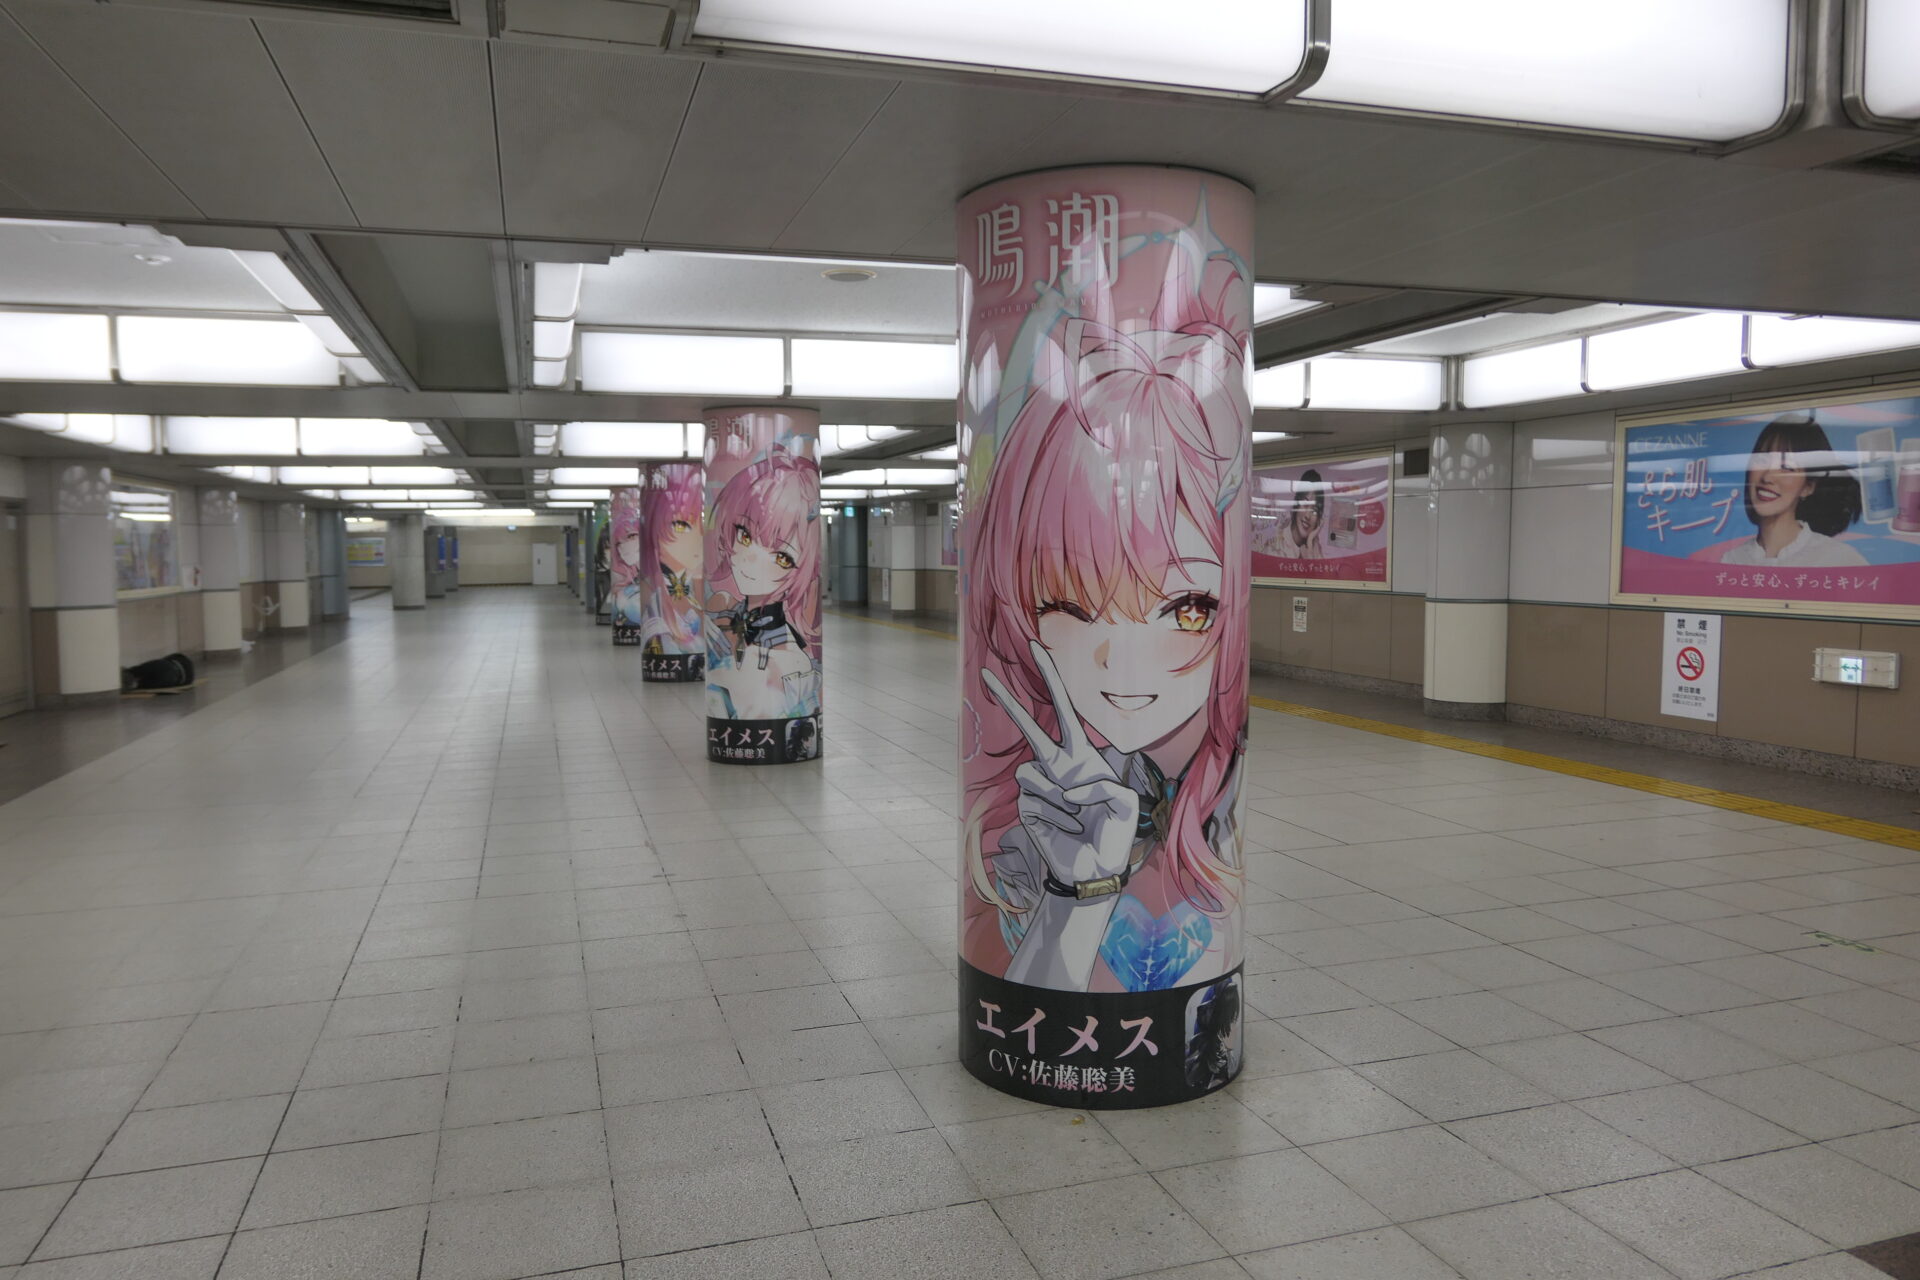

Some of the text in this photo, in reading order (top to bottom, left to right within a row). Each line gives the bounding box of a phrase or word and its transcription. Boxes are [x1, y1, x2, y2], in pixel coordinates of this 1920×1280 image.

[976, 191, 1120, 298] 鳴潮
[1647, 488, 1741, 543] キープ
[1715, 571, 1880, 591] ずっと安心、ずっとキレイ
[709, 727, 776, 746] エイメス
[976, 999, 1159, 1060] エイメス
